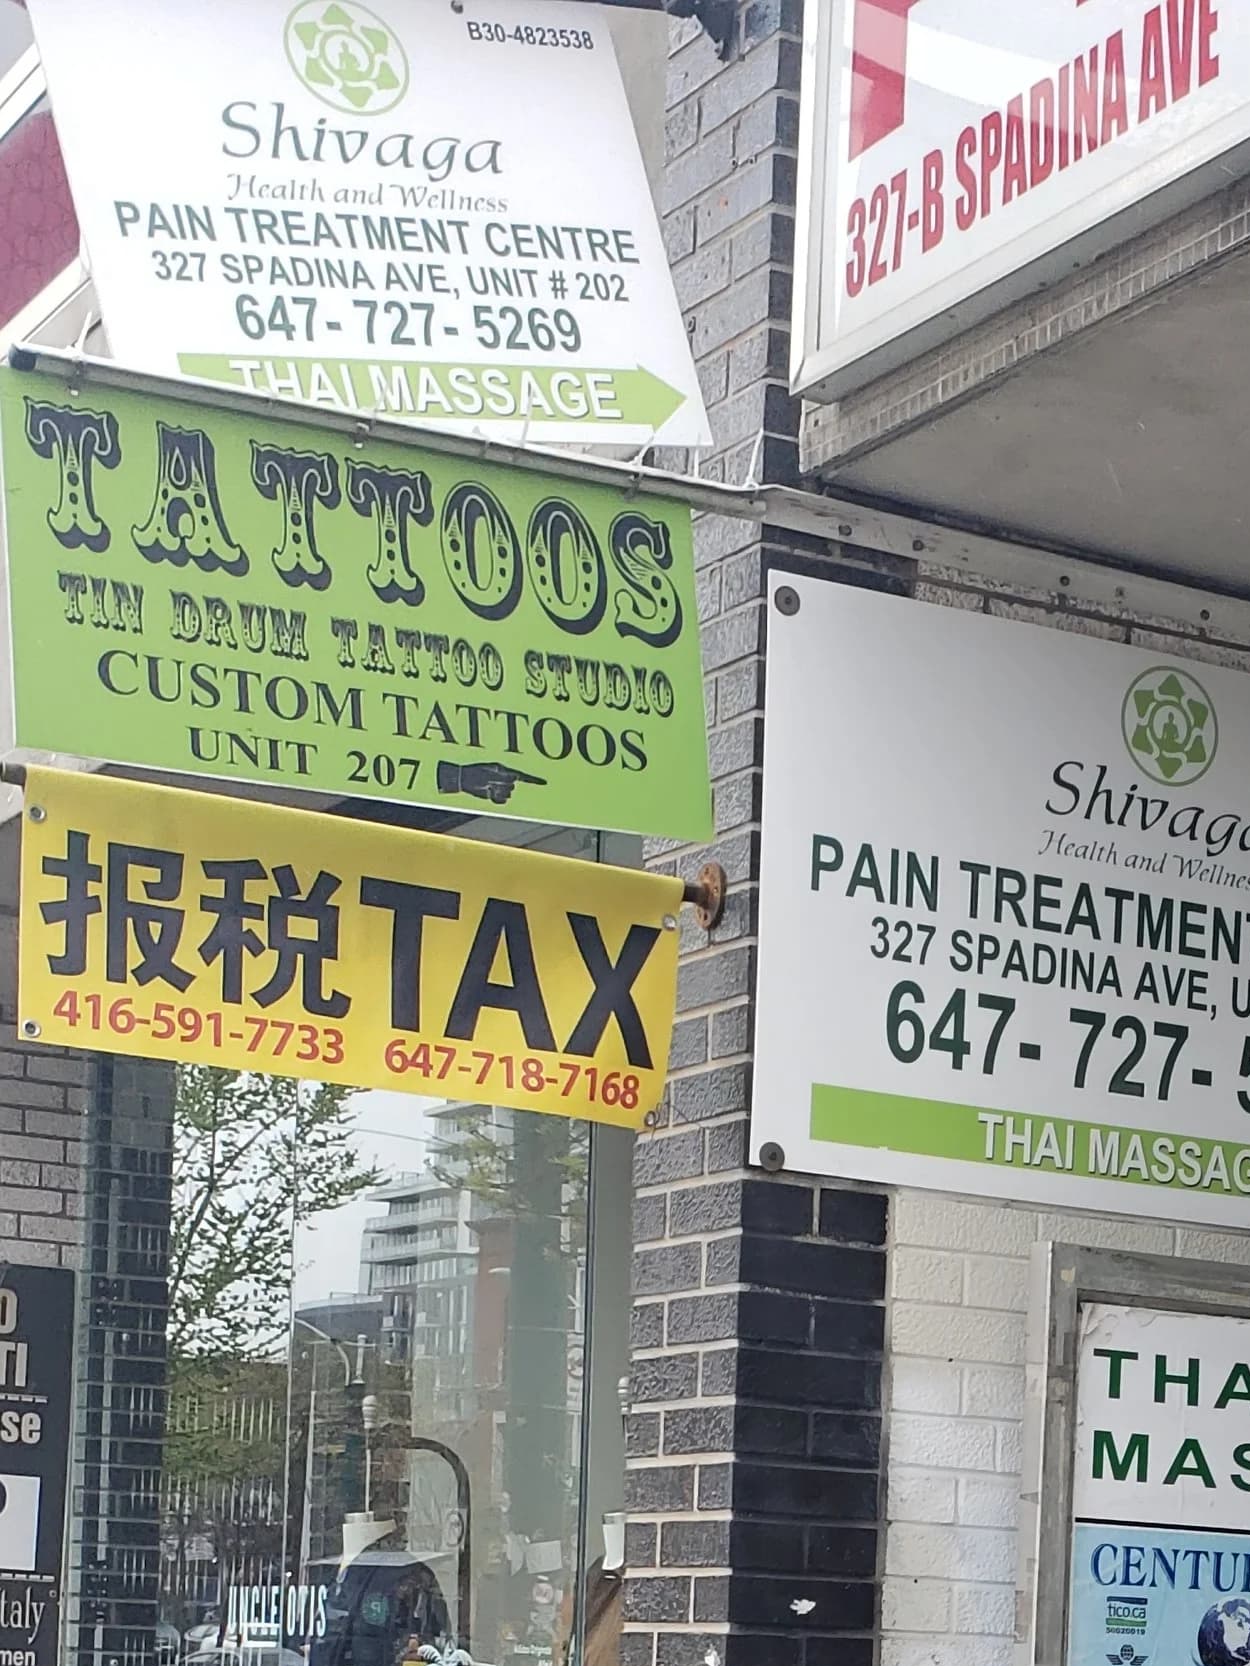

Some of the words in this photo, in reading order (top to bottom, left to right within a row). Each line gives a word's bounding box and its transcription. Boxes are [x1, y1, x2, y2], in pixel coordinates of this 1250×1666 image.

[467, 21, 594, 50] B30-4823538
[221, 101, 503, 180] Shivaga
[845, 147, 945, 300] 327-B
[954, 28, 1129, 232] SPADINA
[1137, 0, 1220, 125] AVE
[227, 173, 324, 202] Health
[333, 182, 384, 207] and
[391, 185, 508, 214] Wellness
[114, 201, 216, 242] PAIN
[224, 207, 471, 256] TREATMENT
[485, 223, 640, 264] CENTRE
[151, 250, 207, 283] 327
[221, 255, 375, 292] SPADINA
[383, 264, 460, 298] AVE,
[472, 268, 537, 298] UNIT
[550, 274, 569, 297] #
[579, 273, 629, 302] 202
[235, 293, 340, 342] 647-
[354, 300, 458, 346] 727-
[476, 305, 582, 353] 5269
[230, 358, 355, 408] THAI
[374, 364, 622, 419] MASSAGE
[23, 396, 684, 648] TATTOOS
[58, 570, 146, 634] TIN
[169, 587, 310, 662] DRUM
[330, 616, 504, 691] TATTOO
[524, 649, 675, 717] STUDIO
[96, 649, 368, 731] CUSTOM
[382, 691, 648, 772] TATTOOS
[185, 726, 319, 776] UNIT
[346, 750, 421, 791] 207
[810, 834, 938, 912] PAIN
[1038, 829, 1118, 869] Health
[1124, 847, 1166, 876] and
[39, 830, 353, 1019] 报税
[359, 876, 663, 1071] TAX
[869, 916, 936, 966] 327
[948, 930, 1122, 999] SPADINA
[1133, 962, 1218, 1021] AVE,
[53, 989, 345, 1065] 416-591-7733
[383, 1038, 641, 1110] 647-718-7168
[884, 980, 1040, 1076] 647-
[1068, 1007, 1213, 1103] 727-
[977, 1112, 1075, 1172] THAI
[228, 1585, 280, 1636] UNCLE
[286, 1586, 328, 1638] OTIS
